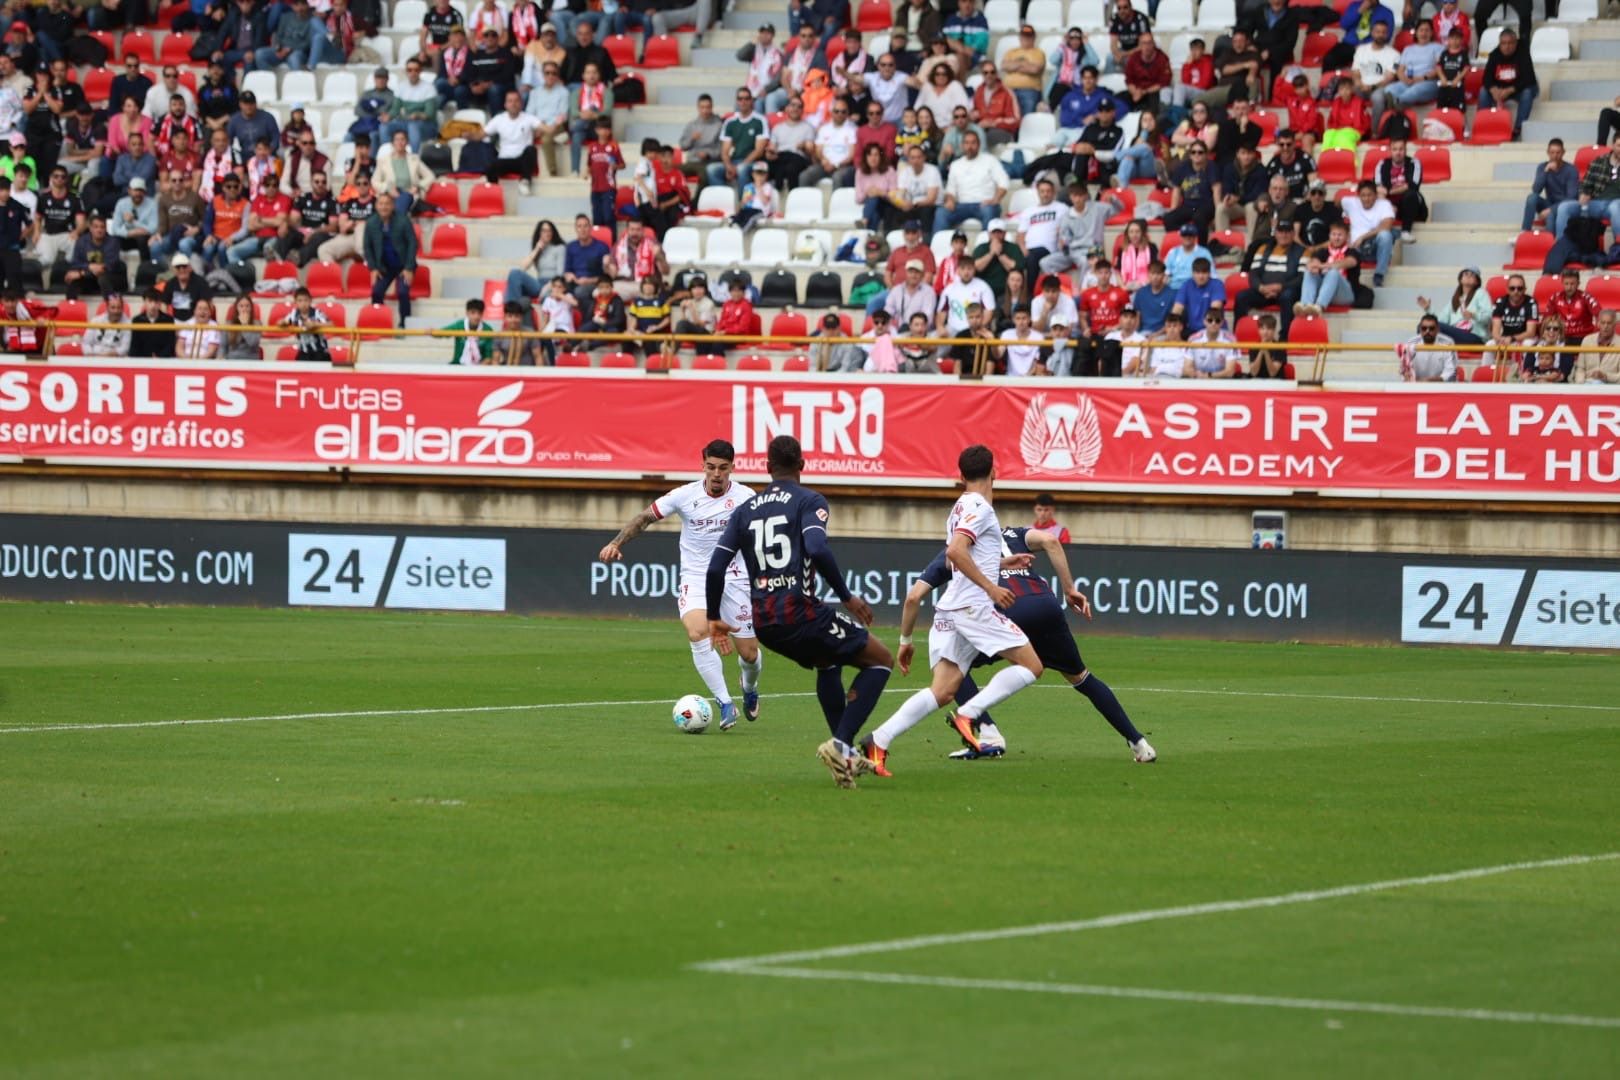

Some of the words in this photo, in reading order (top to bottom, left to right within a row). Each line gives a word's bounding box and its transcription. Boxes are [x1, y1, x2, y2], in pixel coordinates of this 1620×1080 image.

[0, 370, 248, 417] SORLES
[275, 379, 403, 411] Frutas
[0, 418, 123, 445] servicios
[131, 420, 244, 452] gráficos
[732, 384, 885, 458] INTRO
[1416, 403, 1491, 435] LA
[536, 450, 571, 462] grupo
[803, 458, 885, 473] NFORMÁTICAS
[1144, 453, 1343, 478] ACADEMY
[1414, 446, 1526, 480] DEL
[689, 518, 728, 527] ASPIR
[748, 514, 792, 571] 15
[0, 544, 254, 585] DUCCIONES.COM
[303, 547, 364, 593] 24
[405, 557, 494, 589] siete
[767, 574, 797, 592] galys
[1418, 581, 1489, 630] 24
